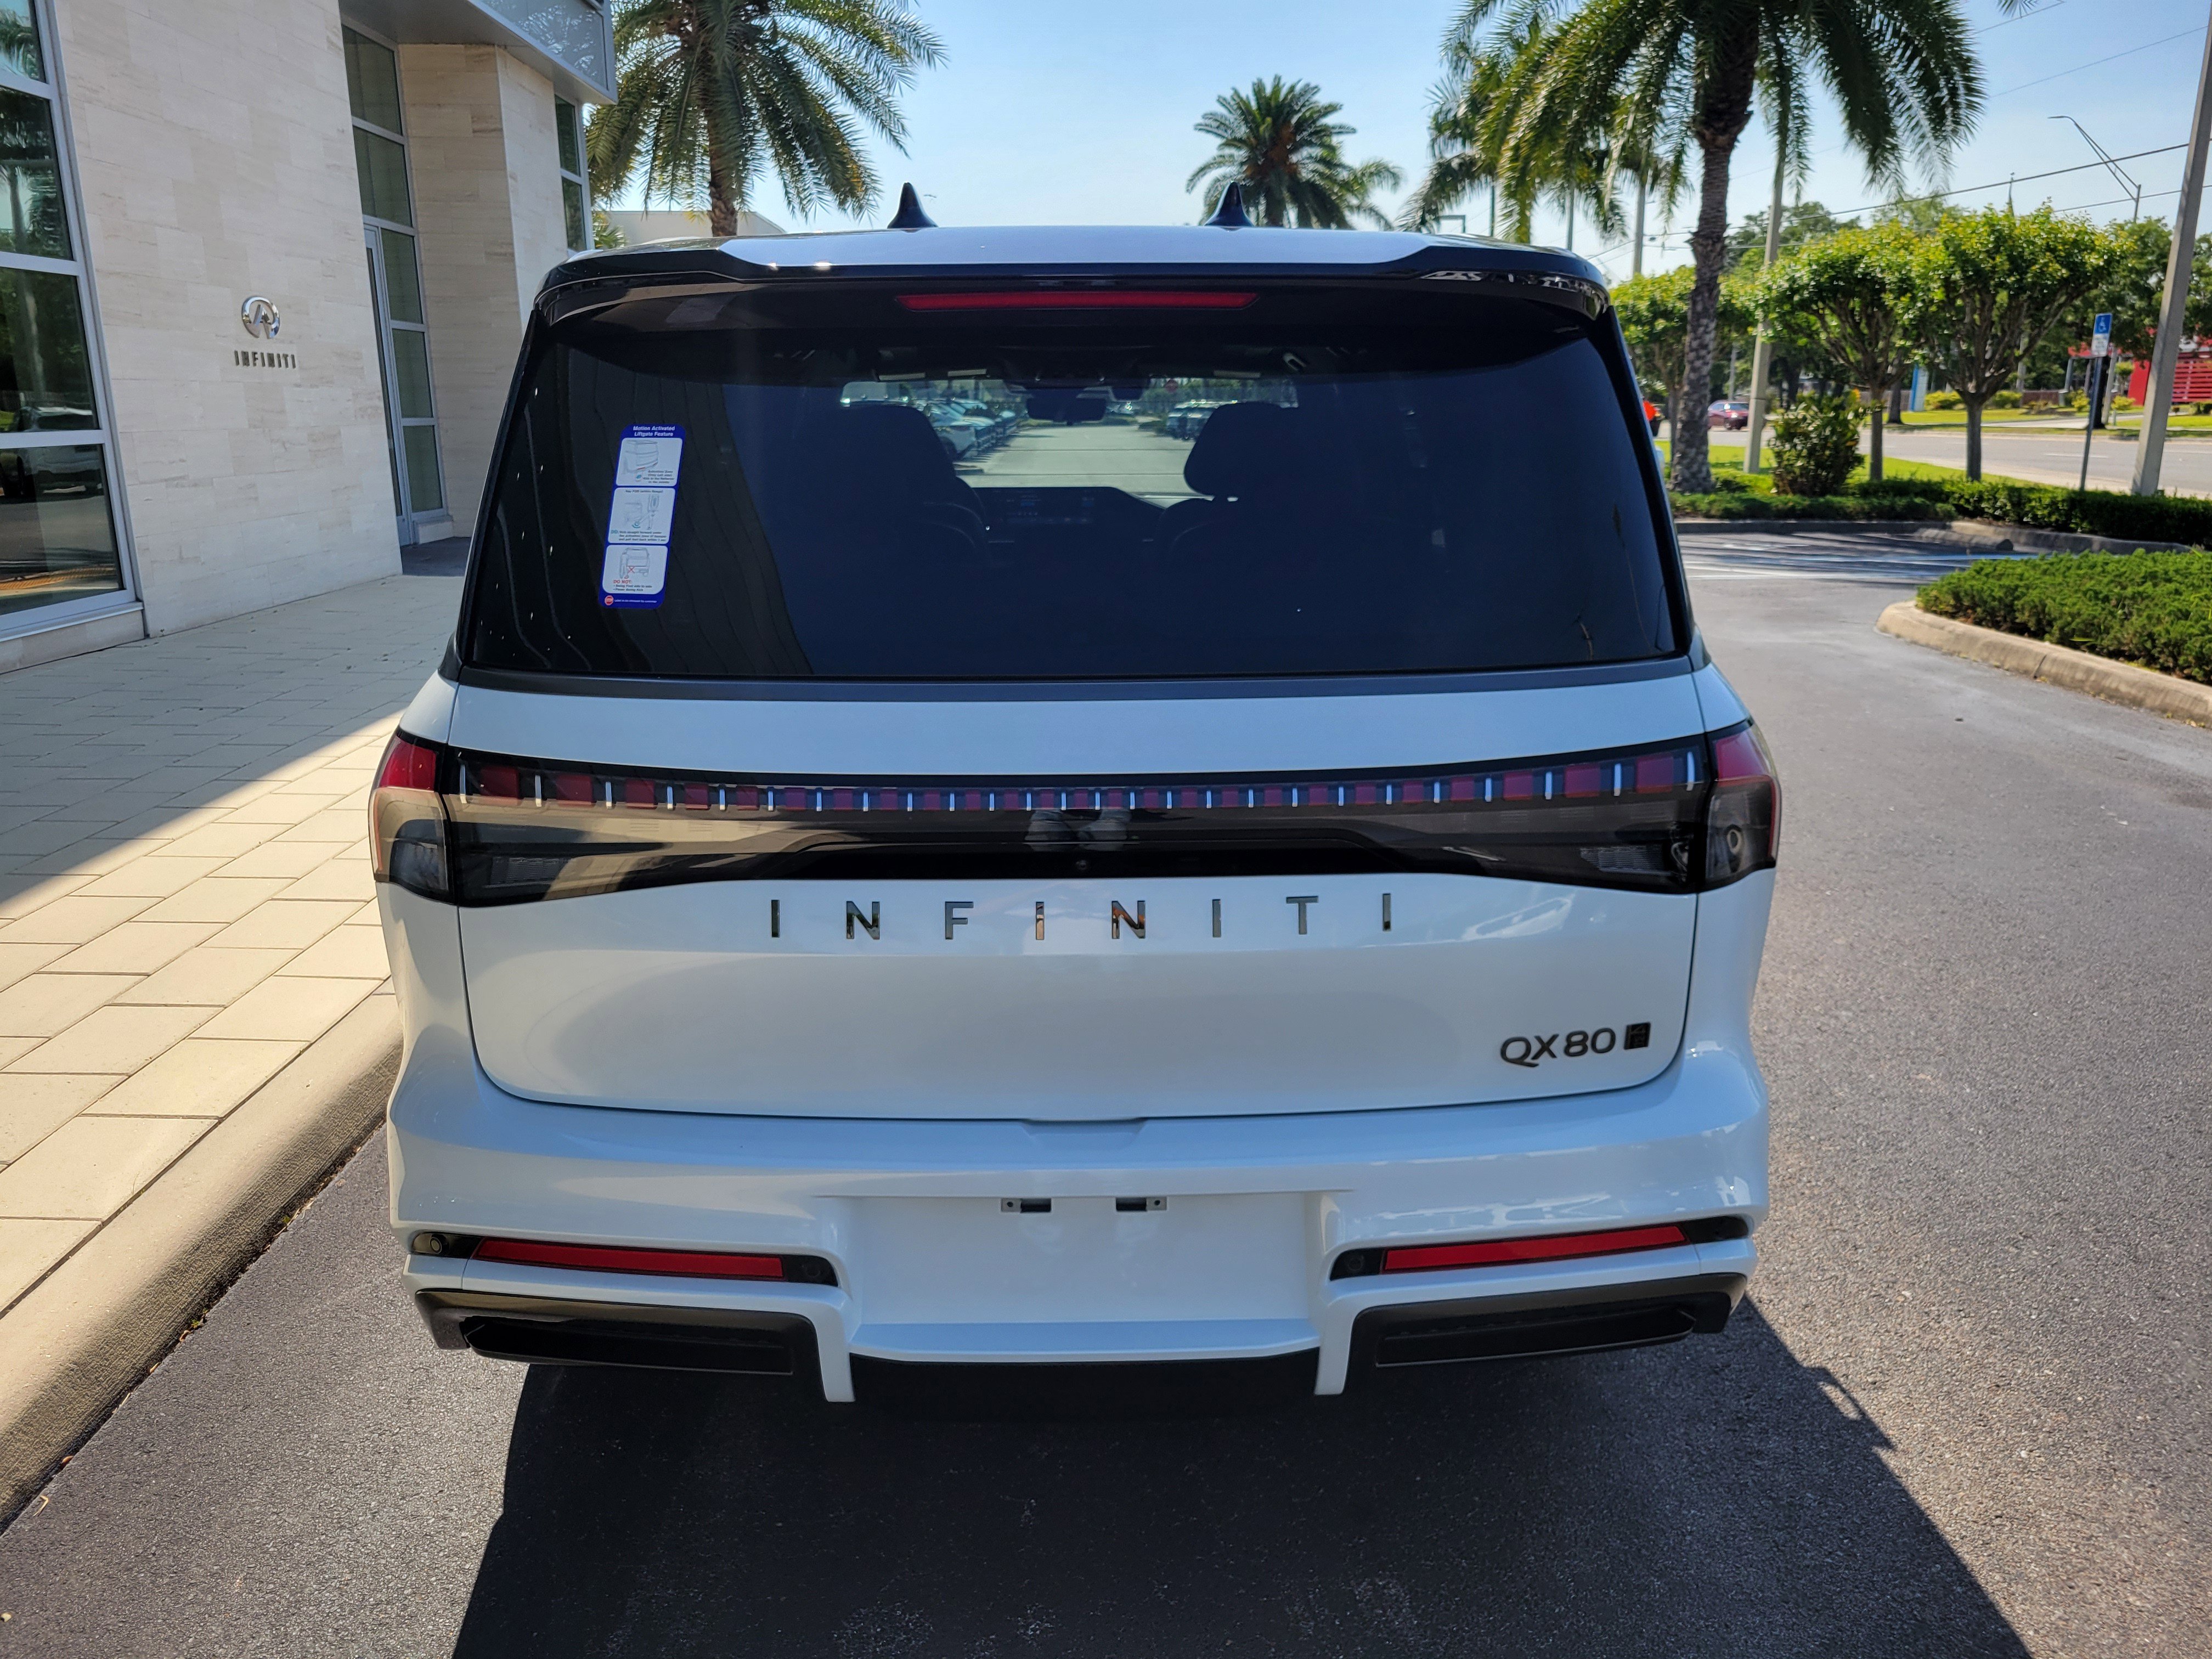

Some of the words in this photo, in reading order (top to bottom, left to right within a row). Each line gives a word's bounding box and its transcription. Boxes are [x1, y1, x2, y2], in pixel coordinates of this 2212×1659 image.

[234, 350, 296, 369] INFINITI
[771, 893, 1391, 940] INFINITI
[1500, 1028, 1616, 1068] QX80
